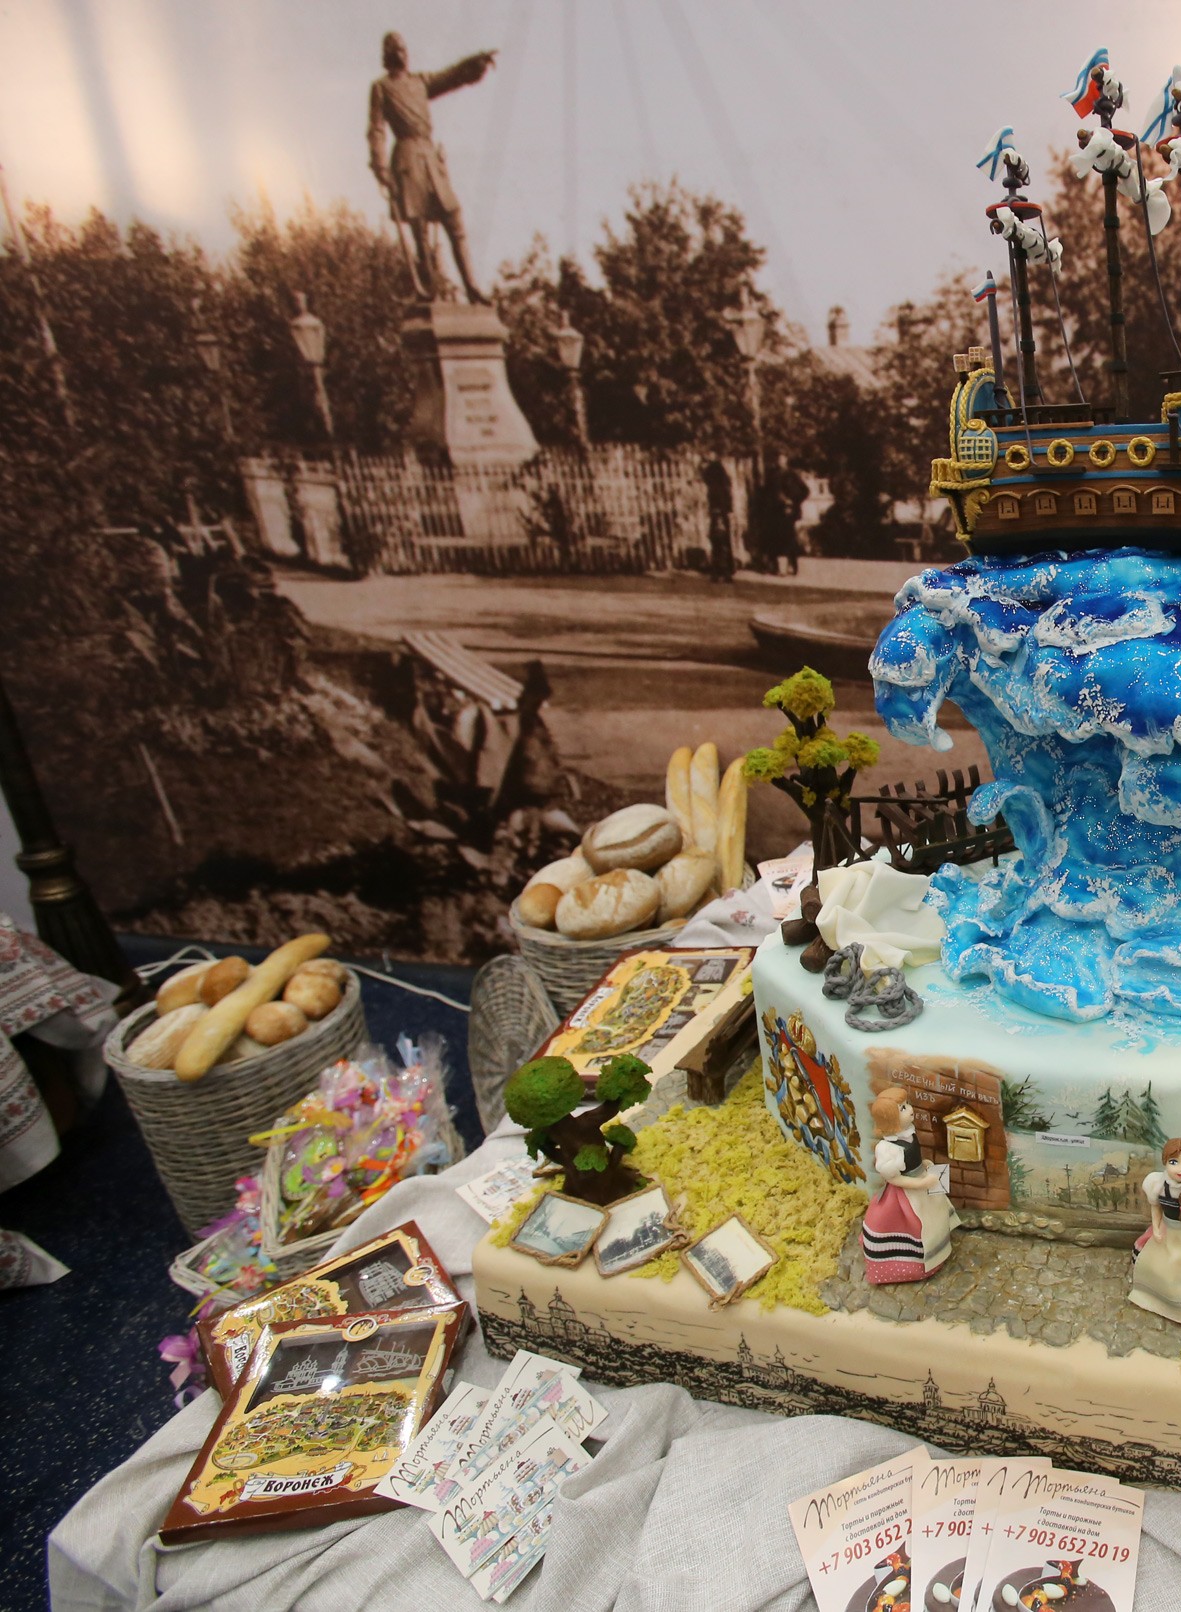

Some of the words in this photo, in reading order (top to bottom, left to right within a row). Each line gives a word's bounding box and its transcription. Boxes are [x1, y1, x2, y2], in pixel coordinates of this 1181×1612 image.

[914, 1090, 936, 1103] ИЗЪ
[233, 1344, 249, 1376] ВОРО
[841, 1515, 865, 1532] Торты
[870, 1499, 904, 1519] пирожные
[1039, 1506, 1062, 1518] Торты
[1067, 1514, 1102, 1527] пирожные
[1073, 1497, 1112, 1512] кондитерских
[849, 1518, 886, 1541] доставкой
[885, 1515, 895, 1523] на
[894, 1508, 908, 1519] дом
[921, 1521, 945, 1538] +7
[948, 1519, 973, 1537] 903
[1041, 1518, 1078, 1533] доставкой
[1086, 1528, 1101, 1537] дом
[819, 1551, 840, 1575] +7
[843, 1538, 872, 1565] 903
[875, 1523, 903, 1549] 652
[904, 1518, 913, 1535] 2
[1003, 1525, 1027, 1541] +7
[1027, 1528, 1056, 1547] 903
[1058, 1535, 1087, 1555] 652
[1088, 1541, 1109, 1559] 20
[1112, 1546, 1130, 1563] 19
